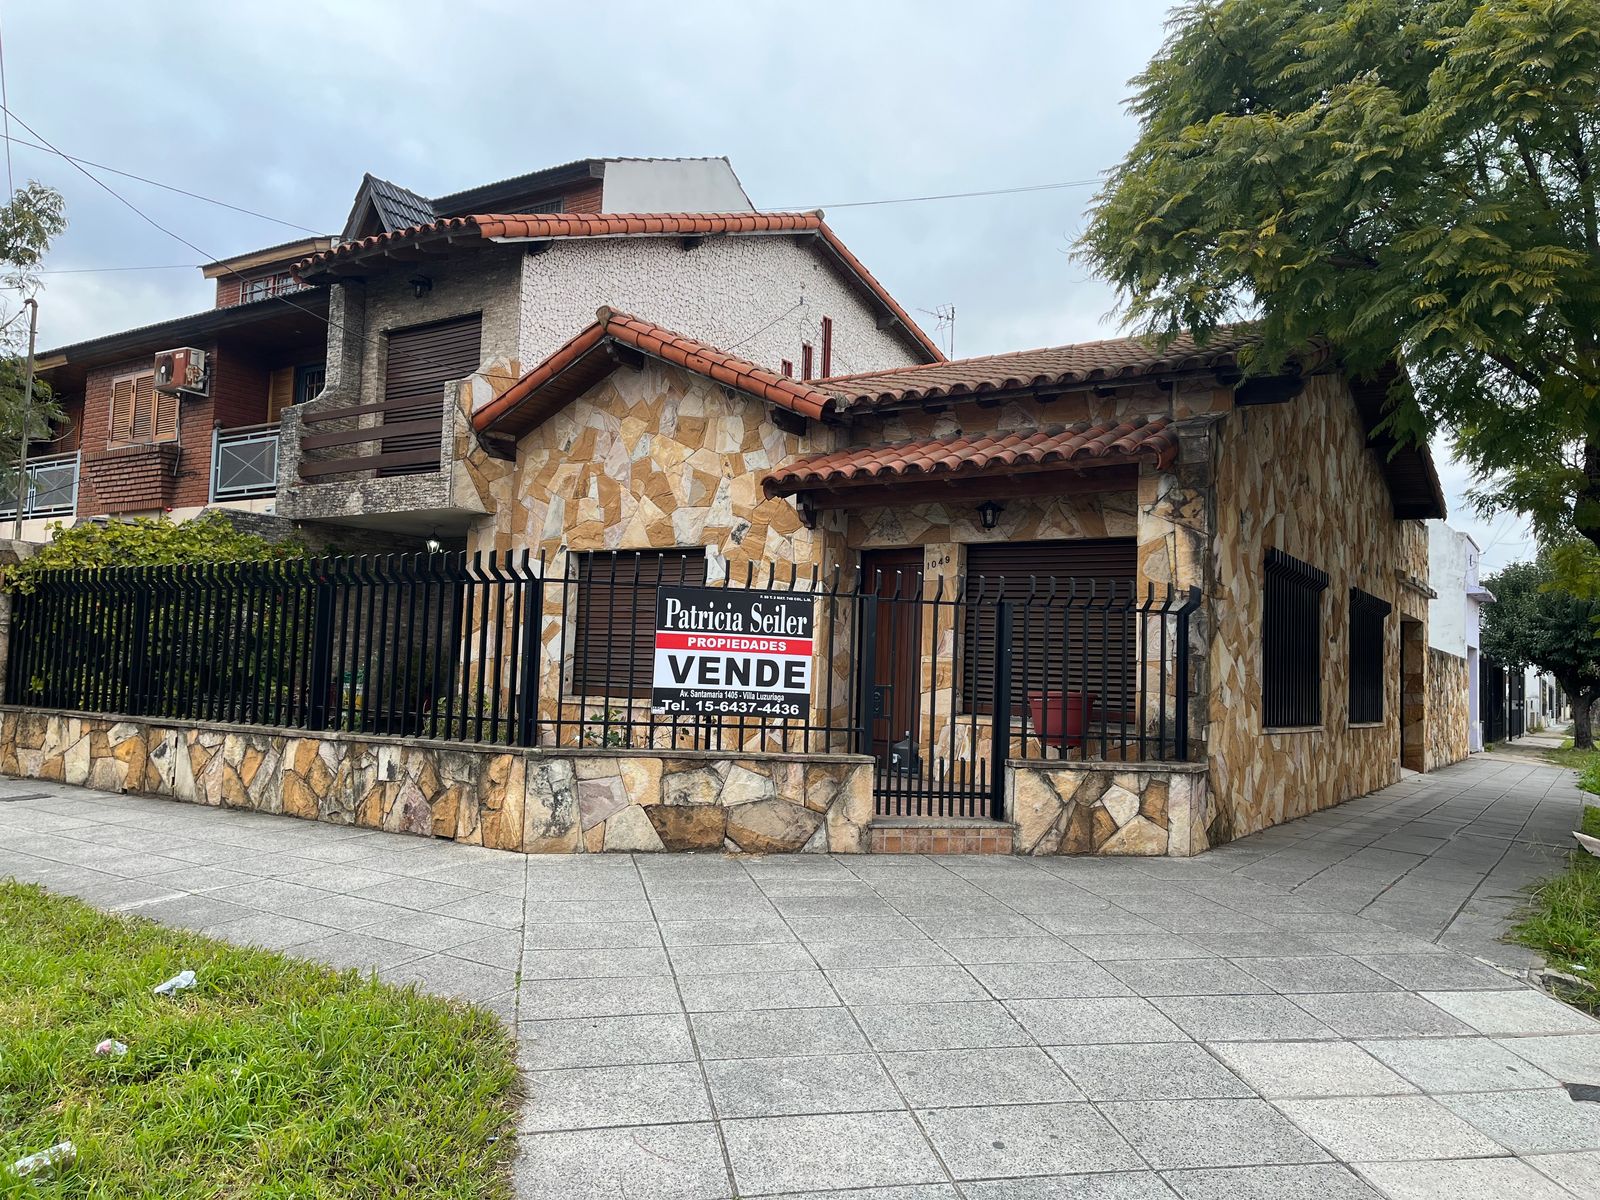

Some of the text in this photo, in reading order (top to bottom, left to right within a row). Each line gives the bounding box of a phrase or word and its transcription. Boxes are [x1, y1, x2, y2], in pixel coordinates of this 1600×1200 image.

[927, 556, 950, 570] 1049
[664, 597, 808, 635] Patricia Seiler
[687, 637, 787, 651] PROPIEDADES
[667, 654, 806, 690] VENDE
[679, 689, 690, 698] Av.
[724, 690, 738, 699] 1405
[742, 691, 756, 700] Villa
[756, 692, 785, 703] Luzuriaga
[661, 699, 690, 711] Tel.
[695, 700, 800, 715] 15-6437-4436
